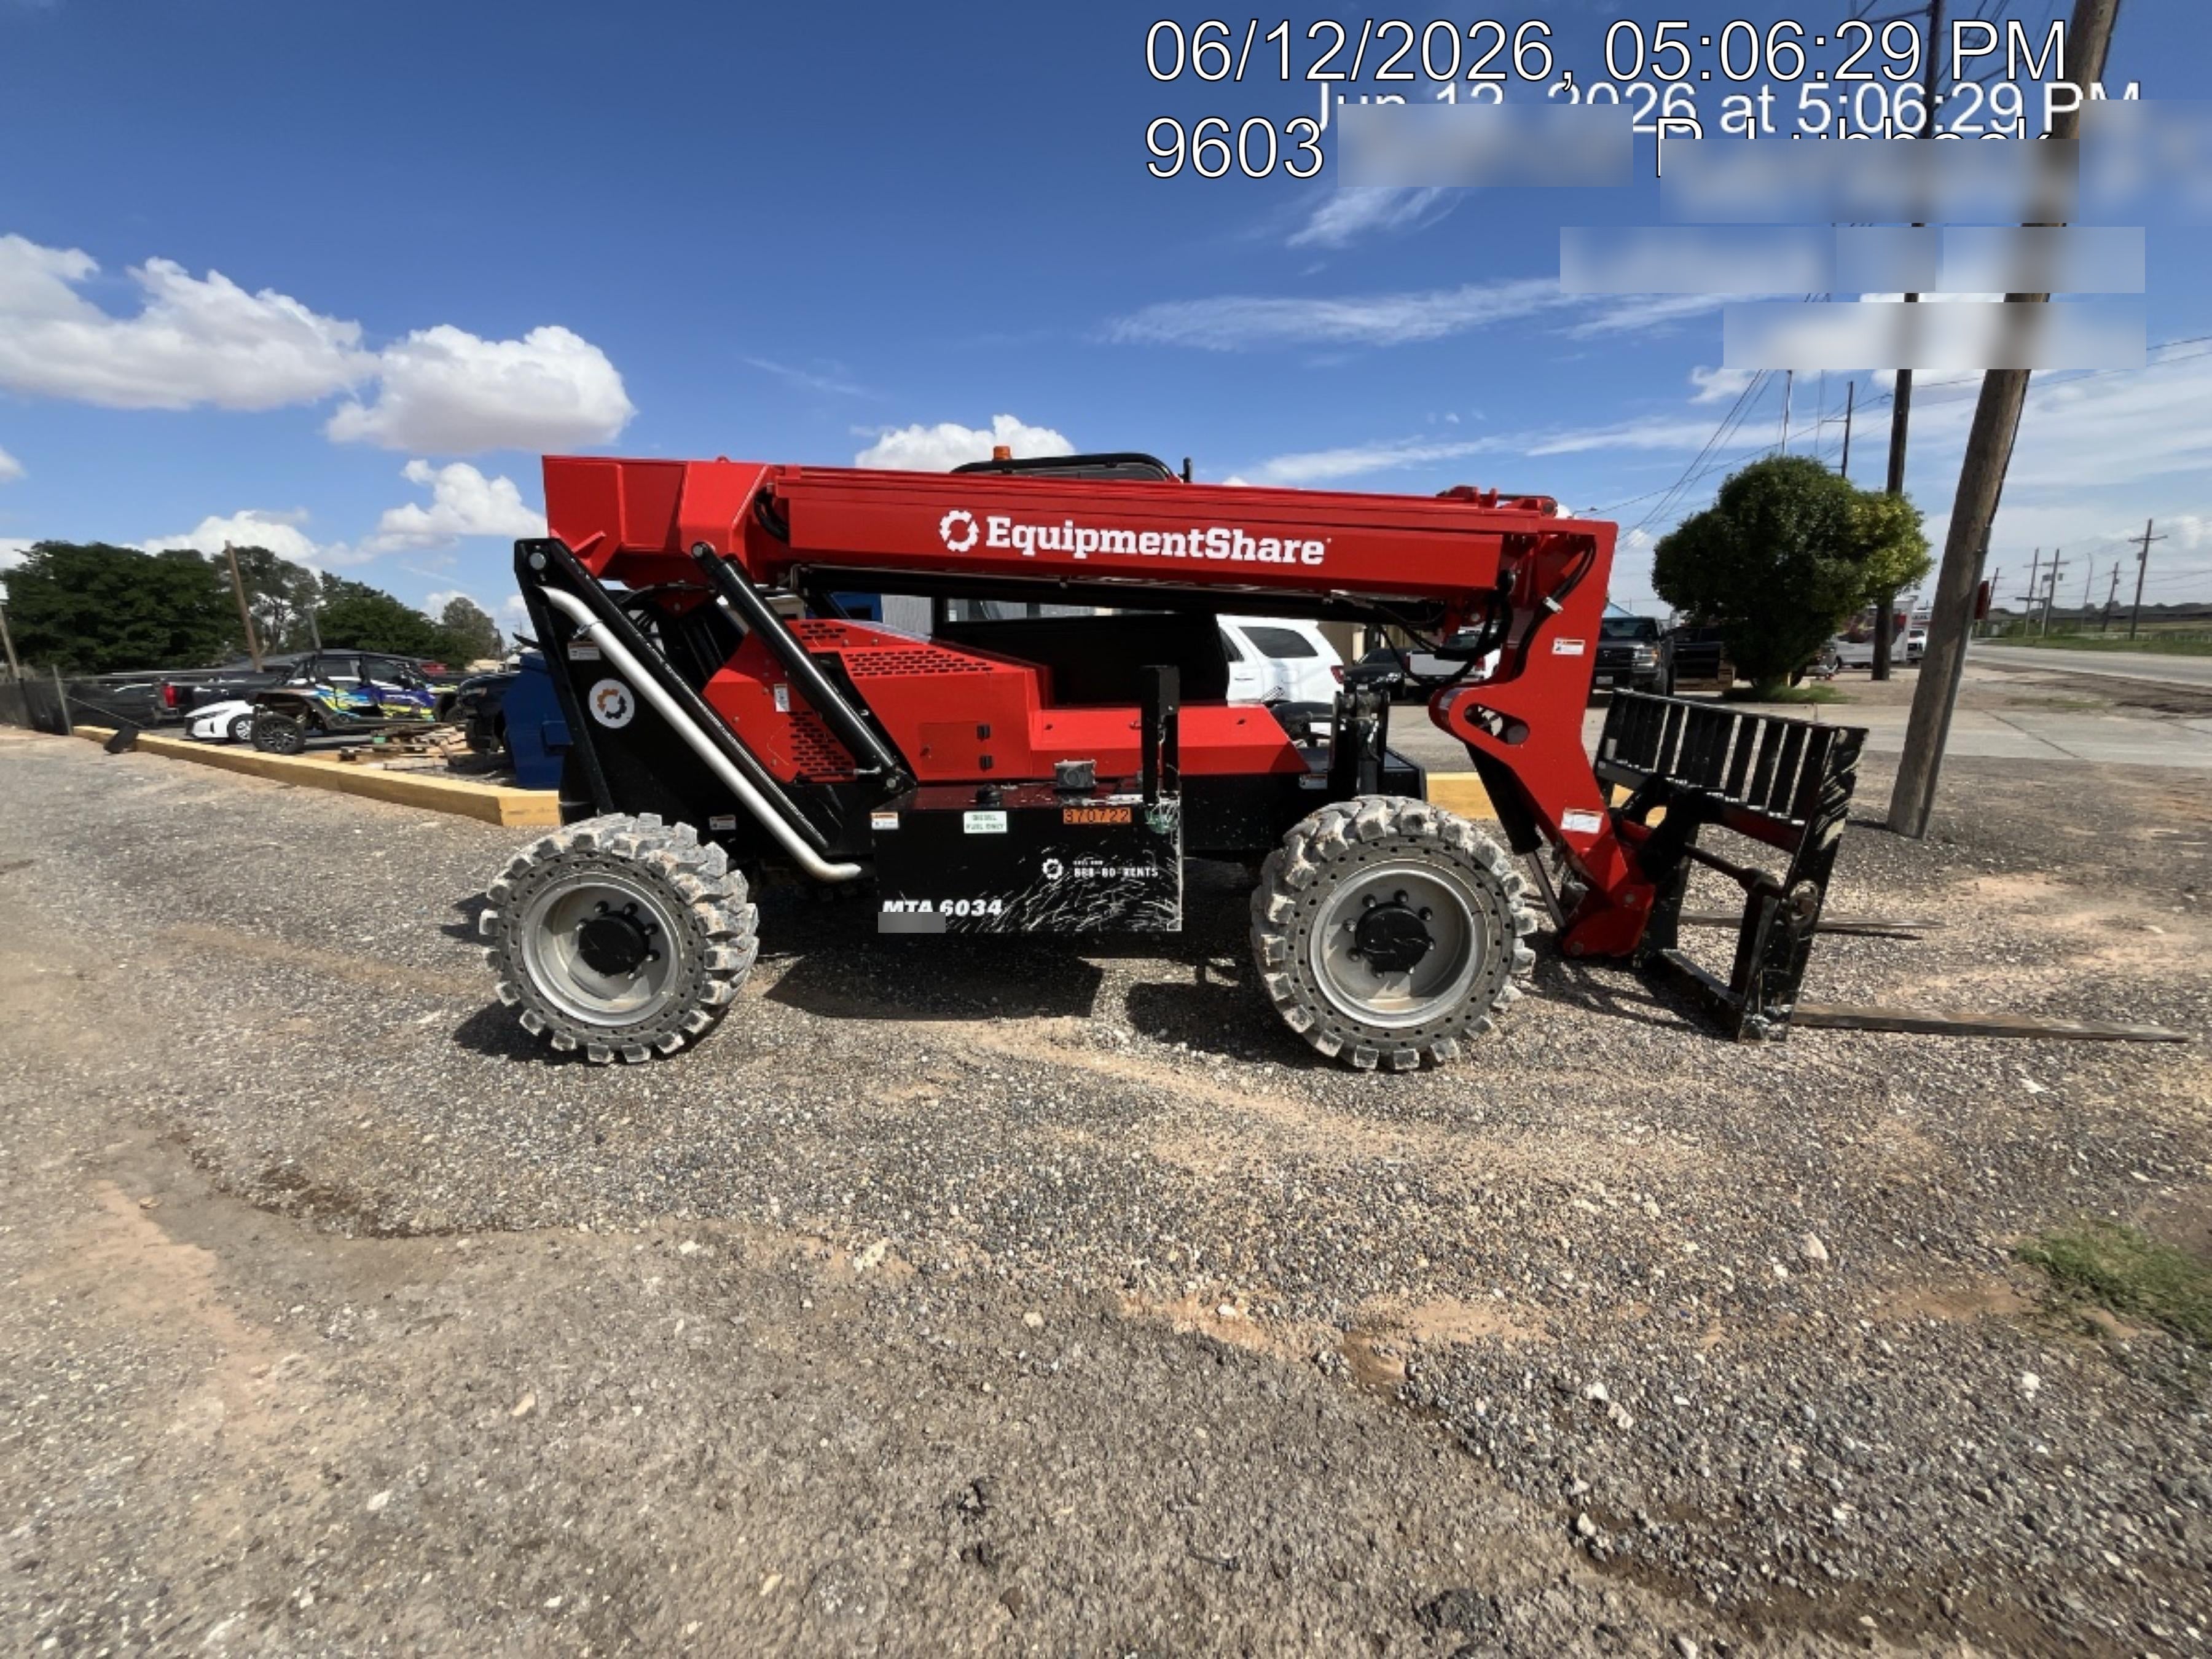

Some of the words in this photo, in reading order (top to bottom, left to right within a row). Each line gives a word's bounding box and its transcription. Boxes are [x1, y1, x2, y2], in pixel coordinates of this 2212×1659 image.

[986, 516, 1324, 565] EquipmentShare
[882, 899, 934, 912] MTA
[939, 899, 1002, 916] 6034
